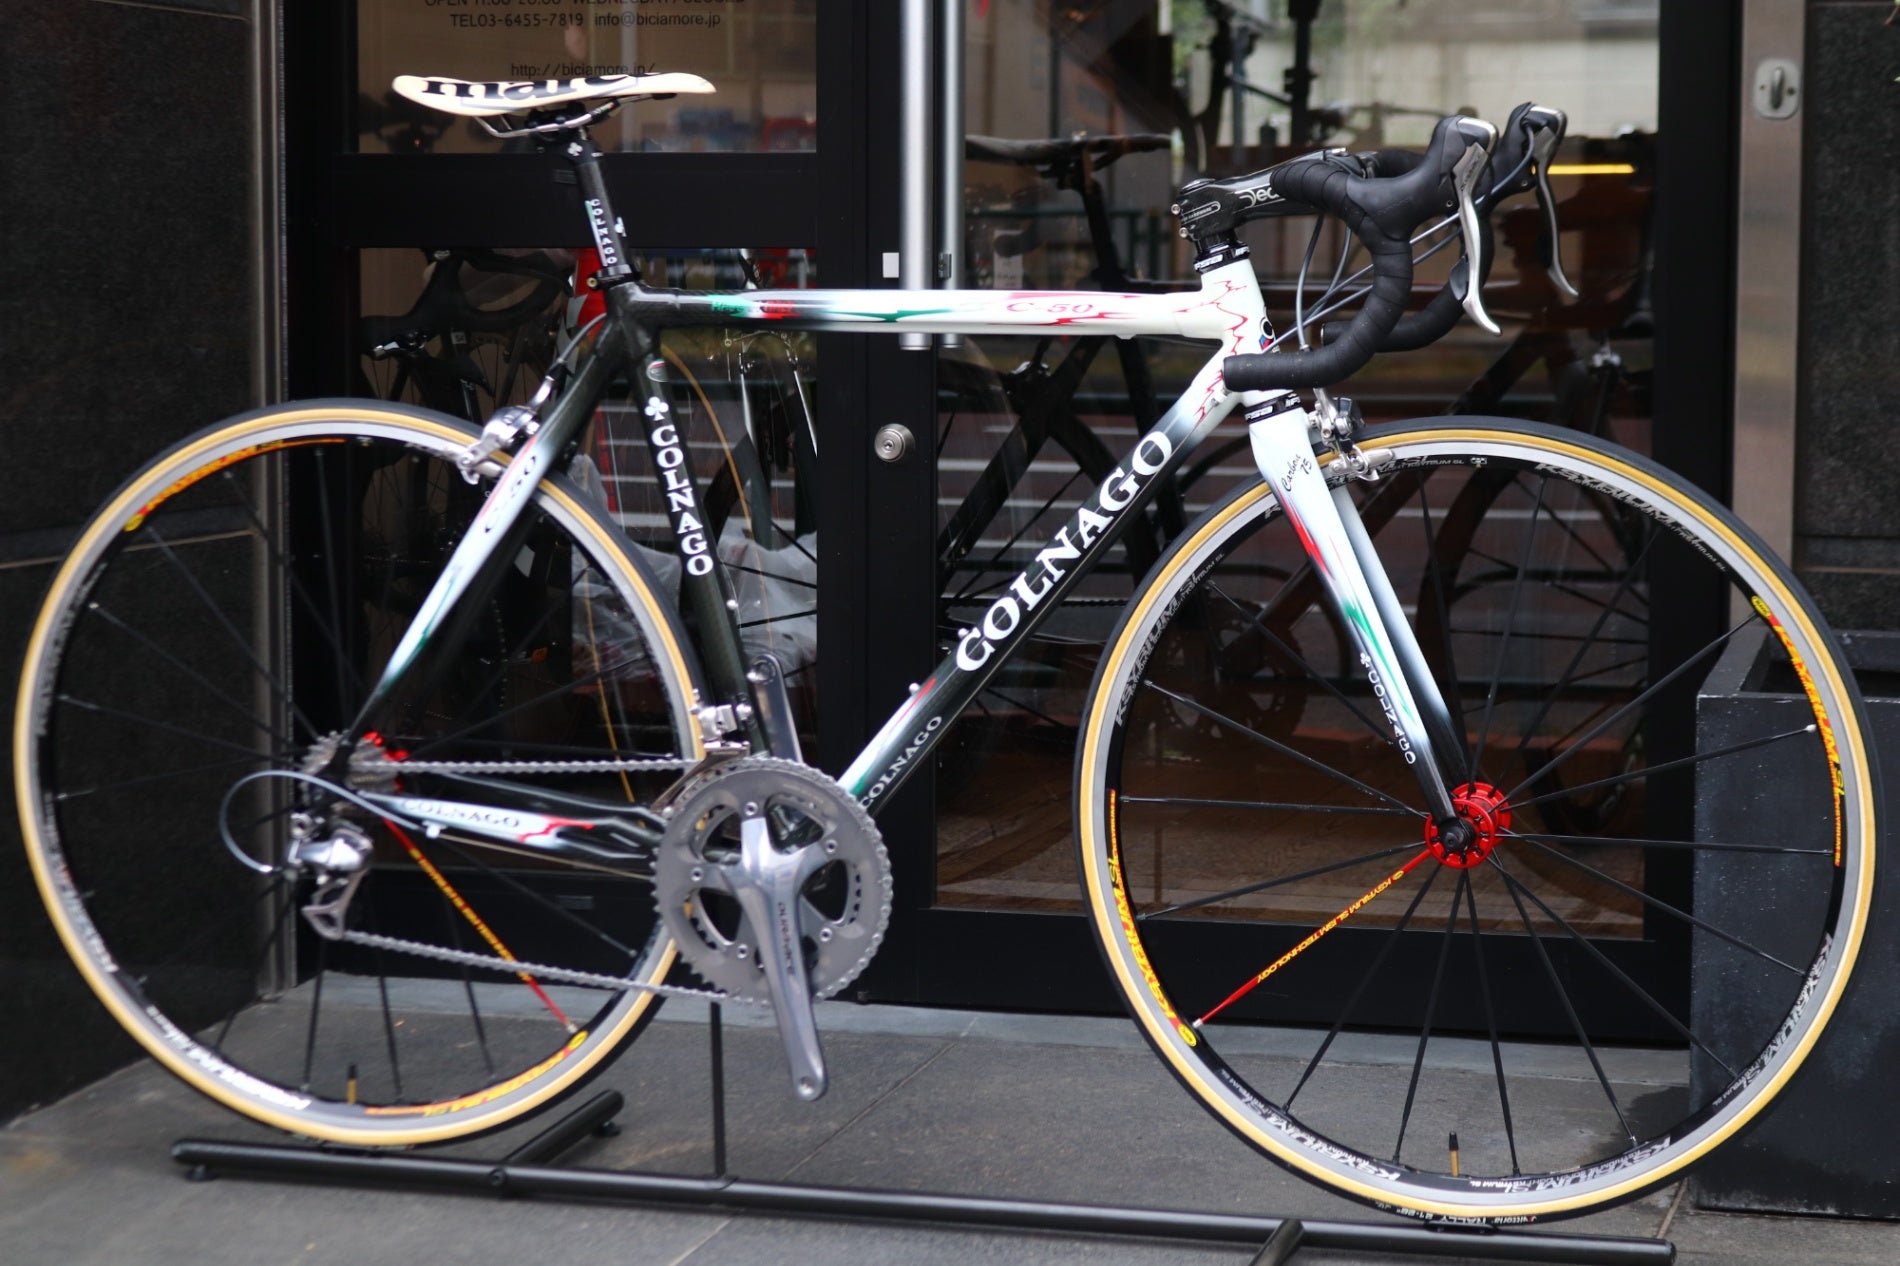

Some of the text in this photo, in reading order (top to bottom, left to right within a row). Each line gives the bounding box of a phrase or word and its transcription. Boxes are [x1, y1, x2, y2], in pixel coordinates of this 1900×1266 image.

[449, 11, 722, 28] TEL03-6455-7819 info@biciamore.jp
[590, 198, 618, 264] COLNAGO
[1006, 302, 1094, 313] C-50
[650, 424, 714, 577] COLNAGO
[955, 430, 1173, 672] COLNAGO
[1367, 669, 1417, 764] COLNAGO
[857, 715, 943, 810] COLNAGO
[402, 799, 520, 829] COLNAGO
[1112, 886, 1176, 1022] KSYRIUM
[1266, 1113, 1400, 1181] KSYRIUM
